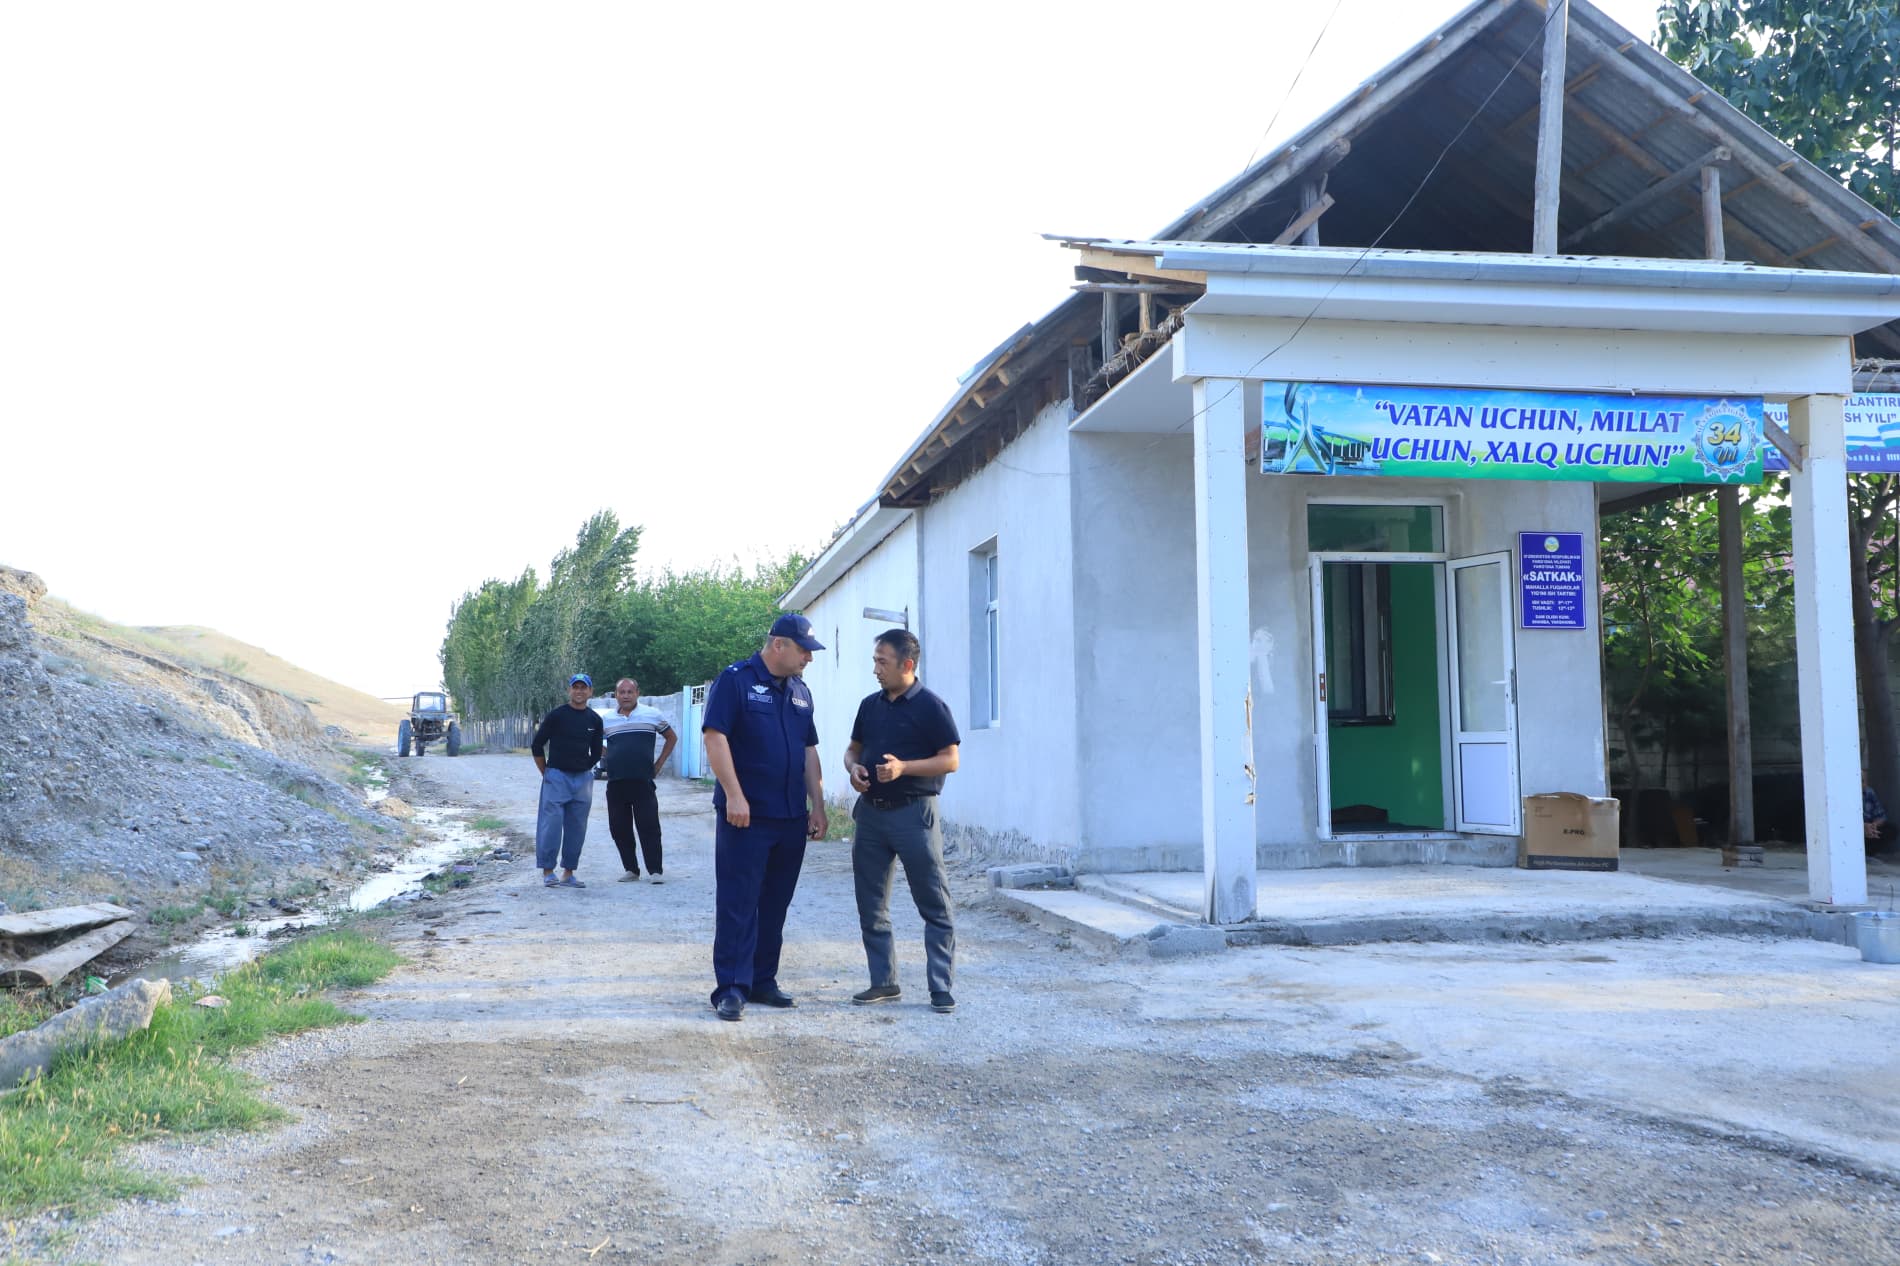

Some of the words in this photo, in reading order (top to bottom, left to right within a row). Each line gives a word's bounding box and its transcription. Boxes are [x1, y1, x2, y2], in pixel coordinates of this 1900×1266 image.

[1375, 401, 1473, 427] “VATAN
[1481, 407, 1583, 435] UCHUN,
[1590, 410, 1684, 432] MILLAT
[1707, 421, 1742, 446] 34
[1371, 437, 1478, 465] UCHUN,
[1483, 441, 1557, 468] XALQ
[1565, 443, 1685, 466] UCHUN!”
[1523, 571, 1582, 581] «SATKAK»
